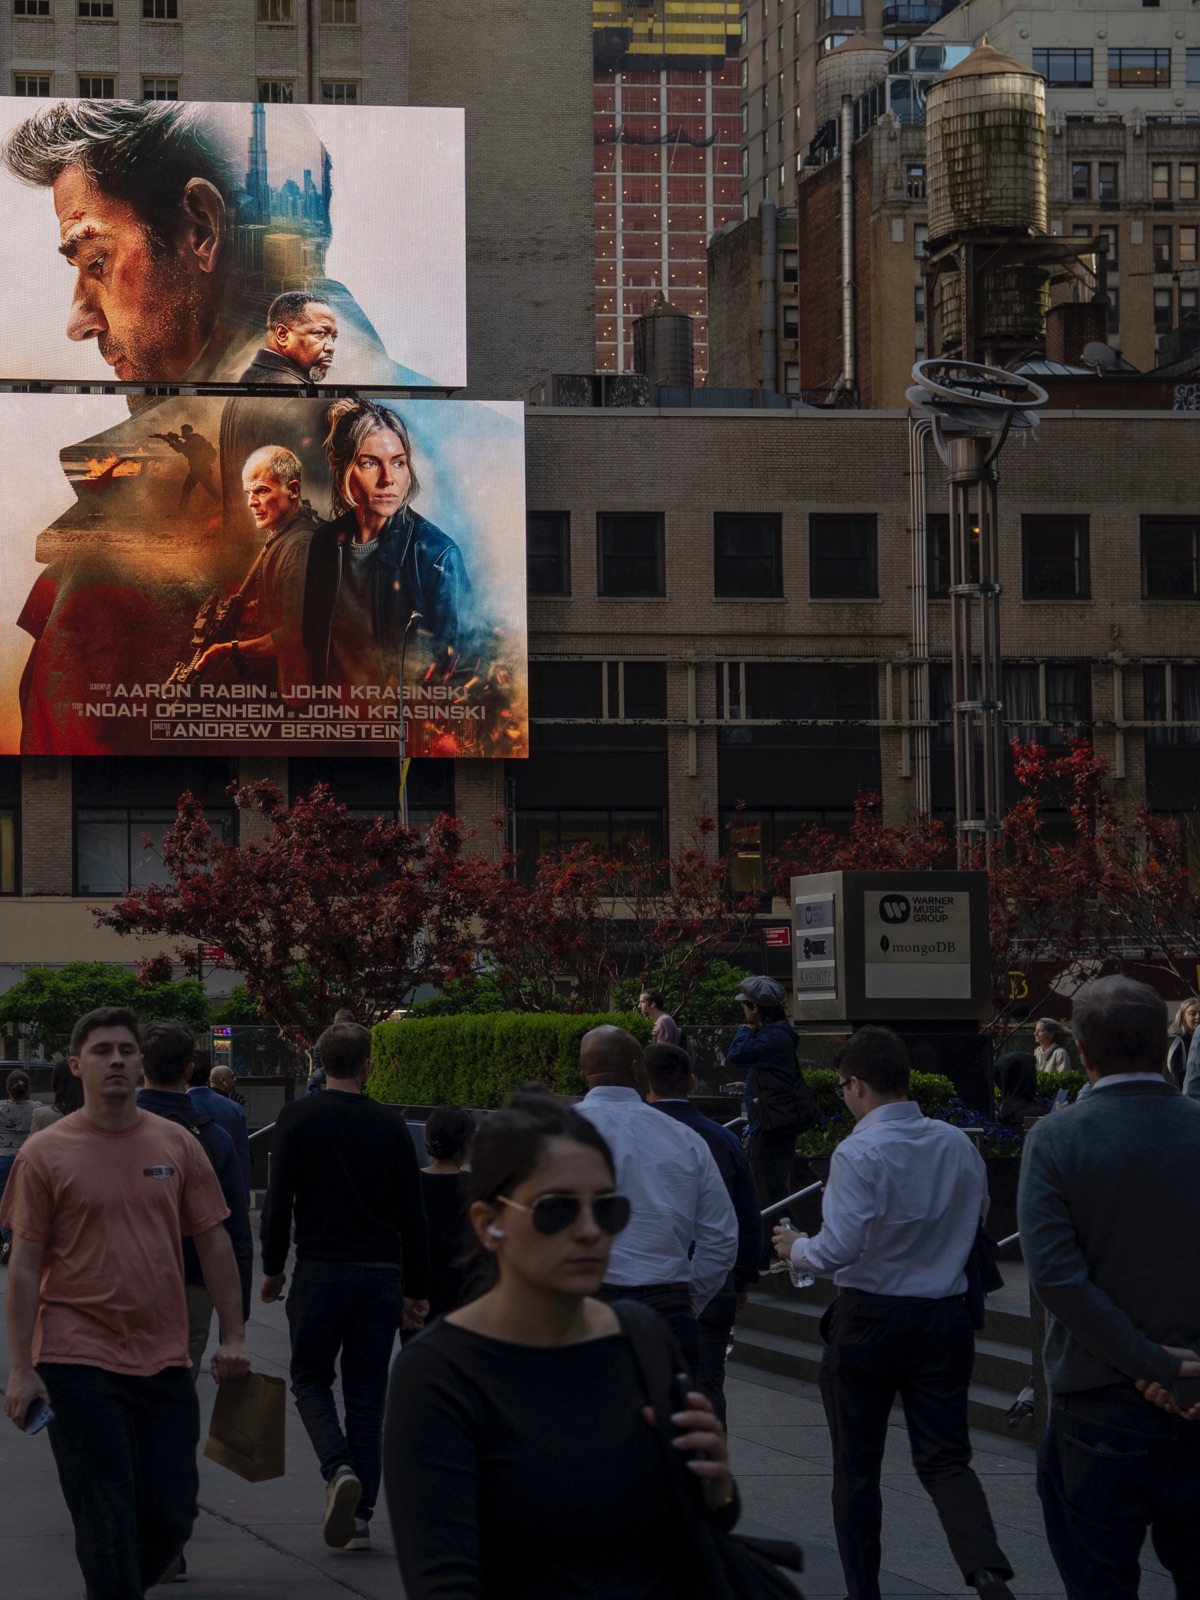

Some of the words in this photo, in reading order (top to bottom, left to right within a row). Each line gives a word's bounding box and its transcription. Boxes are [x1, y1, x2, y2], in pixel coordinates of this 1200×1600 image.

[114, 684, 192, 698] AARON
[200, 684, 267, 699] RABIN
[281, 684, 342, 700] JOHN
[350, 685, 469, 700] KRASINSKI
[86, 702, 148, 718] NOAH
[156, 704, 284, 719] OPPENHEIM
[298, 704, 360, 719] JOHN
[368, 705, 486, 720] KRASINSKI
[172, 723, 273, 738] ANDREW
[280, 724, 405, 739] BERNSTEIN
[912, 896, 954, 905] WARNER
[913, 906, 945, 914] MUSIC
[913, 914, 949, 922] GROUP
[892, 942, 956, 956] mongoDB
[800, 970, 832, 984] KASOWITZ
